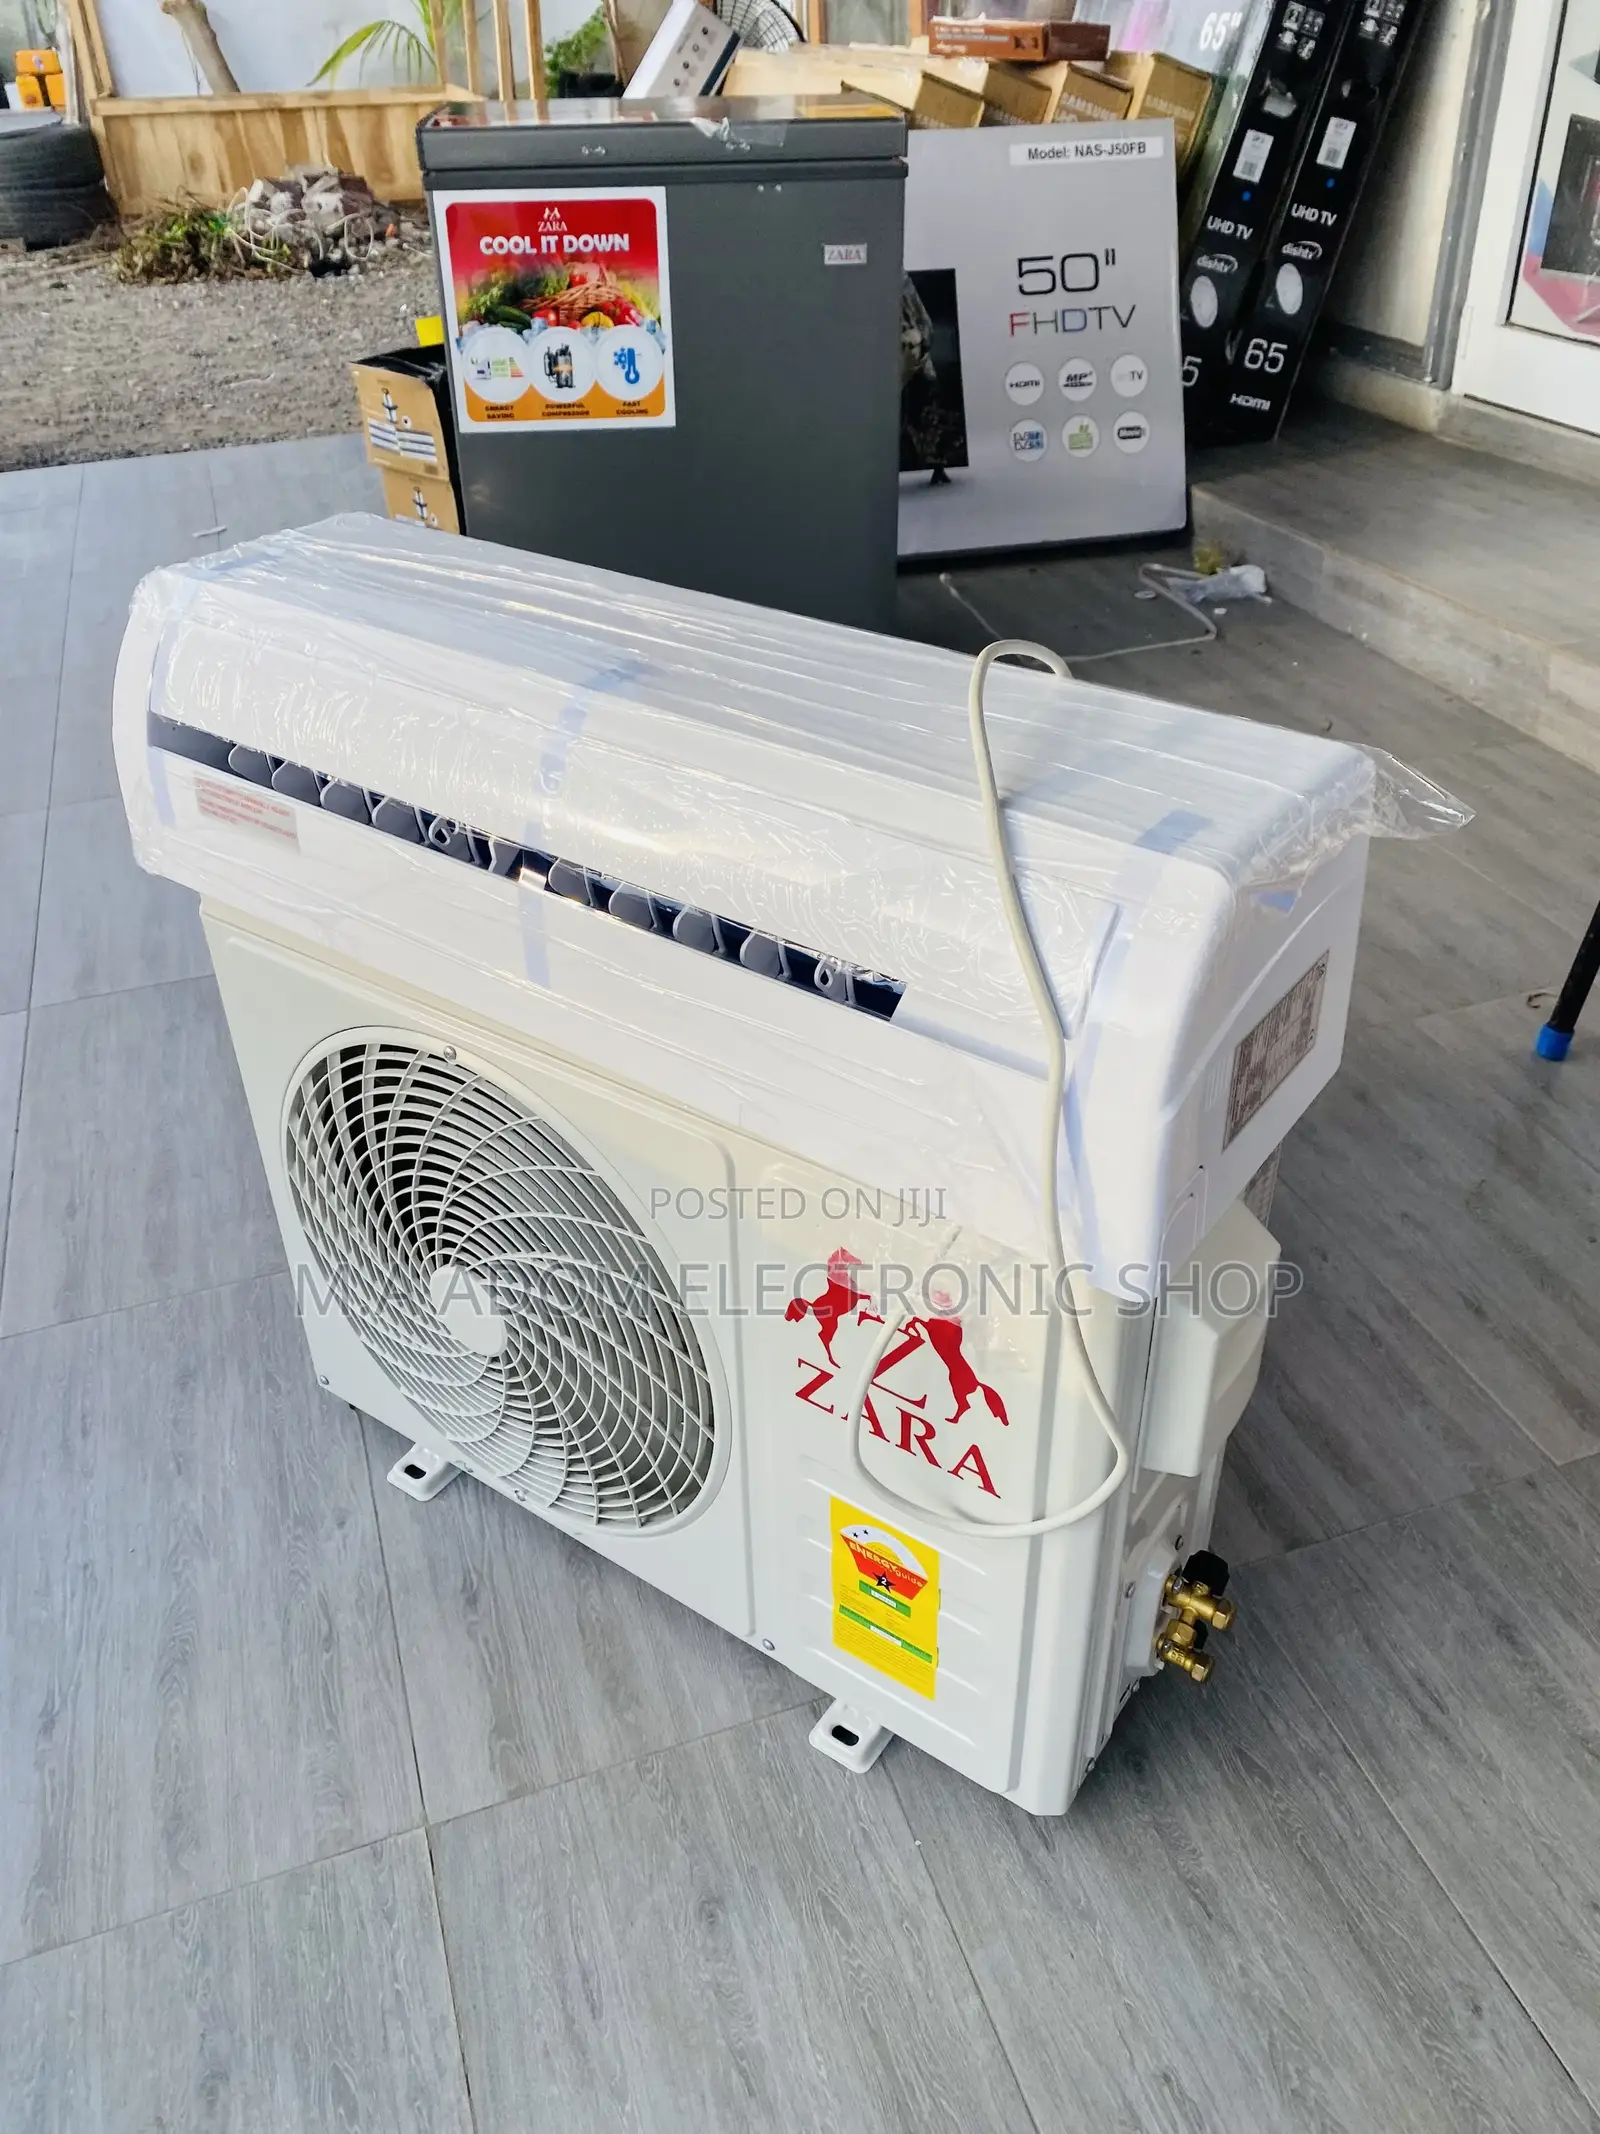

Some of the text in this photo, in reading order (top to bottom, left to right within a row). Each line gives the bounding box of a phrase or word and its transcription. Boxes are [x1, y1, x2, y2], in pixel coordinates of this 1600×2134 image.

[1199, 11, 1243, 52] 65"
[1027, 141, 1147, 160] Model: NAS-J50FB
[1291, 203, 1338, 227] UHD TV
[538, 221, 567, 232] ZARA
[1206, 215, 1254, 240] UHD TV
[479, 233, 629, 255] COOL IT DOWN
[827, 249, 862, 261] ZARA
[1017, 247, 1117, 296] 50"
[1009, 304, 1137, 336] FHDTV
[1244, 338, 1289, 373] 65
[1130, 369, 1144, 381] TV
[616, 408, 649, 416] COOLING
[795, 1357, 1002, 1500] ZARA
[881, 1576, 888, 1586] 2
[895, 1567, 924, 1589] guide
